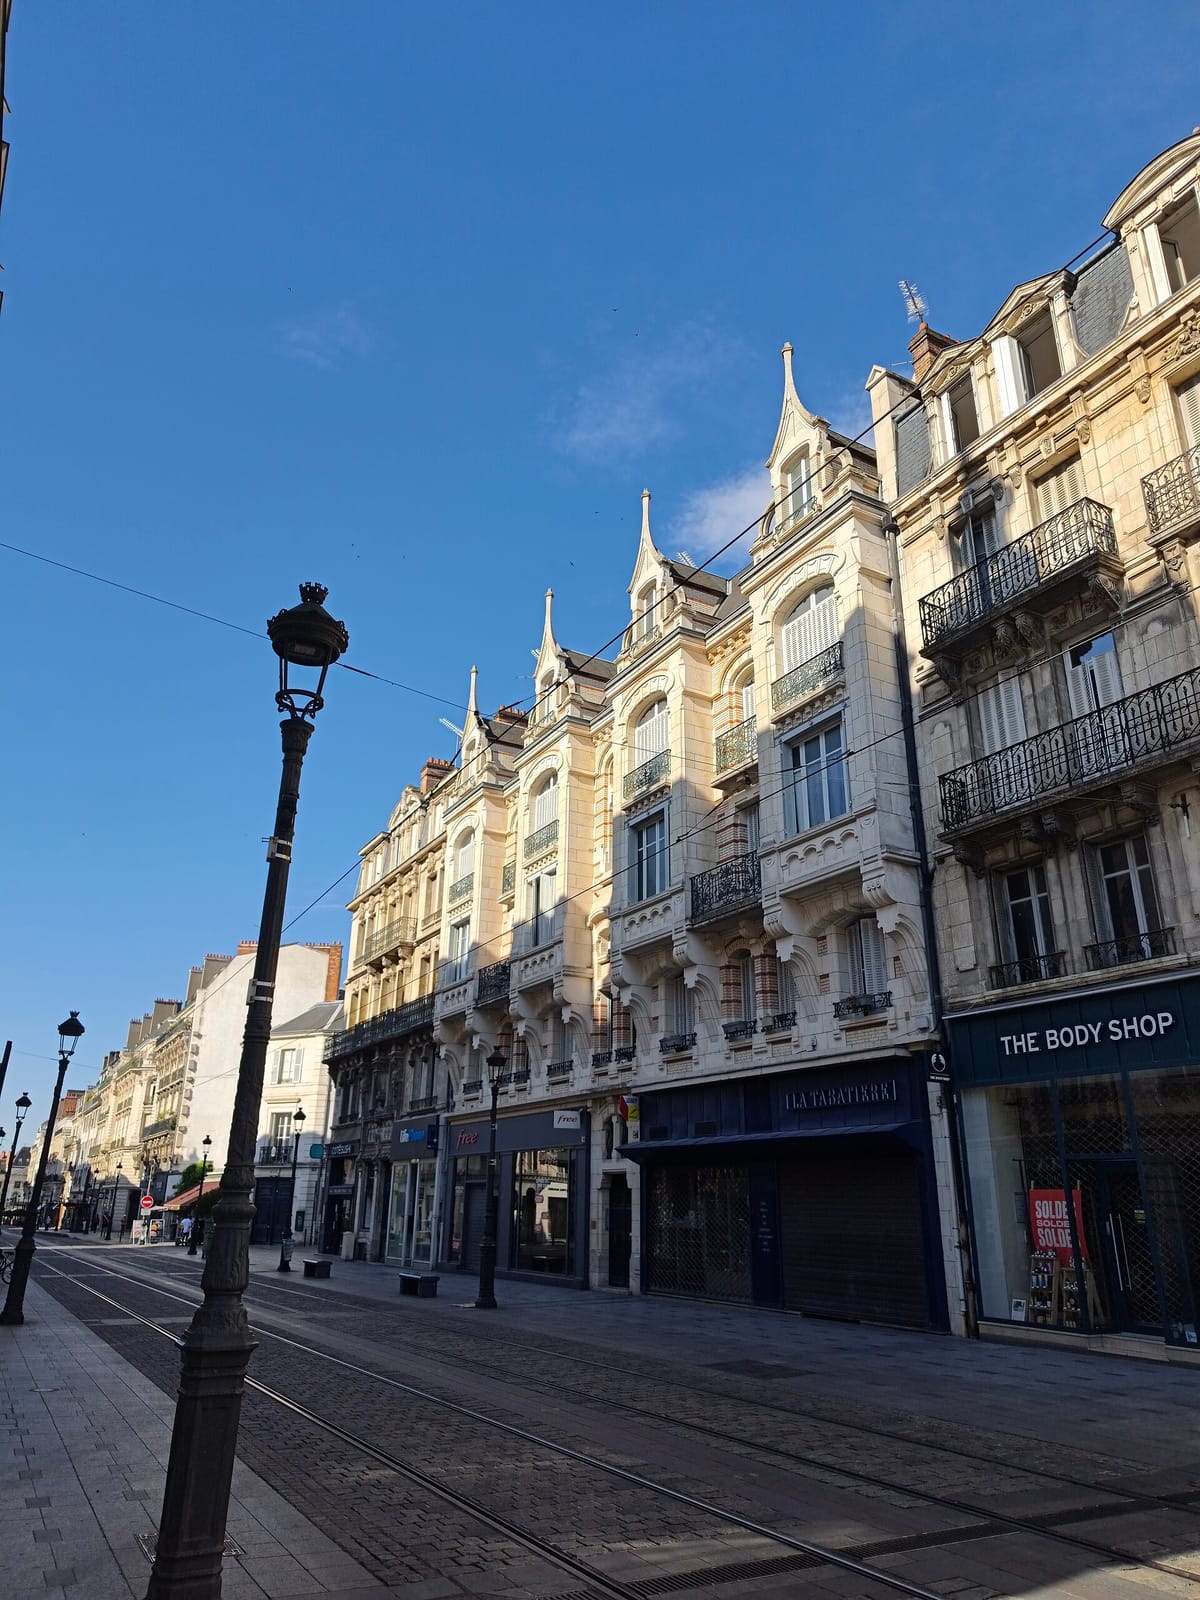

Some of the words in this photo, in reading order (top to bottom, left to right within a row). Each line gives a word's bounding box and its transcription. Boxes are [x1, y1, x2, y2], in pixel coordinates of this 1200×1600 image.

[1000, 1031, 1040, 1056] THE
[1045, 1021, 1103, 1050] BODY
[1107, 1012, 1174, 1041] SHOP
[793, 1091, 807, 1109] LA
[456, 1128, 479, 1152] free
[1035, 1199, 1077, 1220] SOLDE
[1035, 1219, 1071, 1228] SOLDE
[1037, 1227, 1082, 1249] SOLDE
